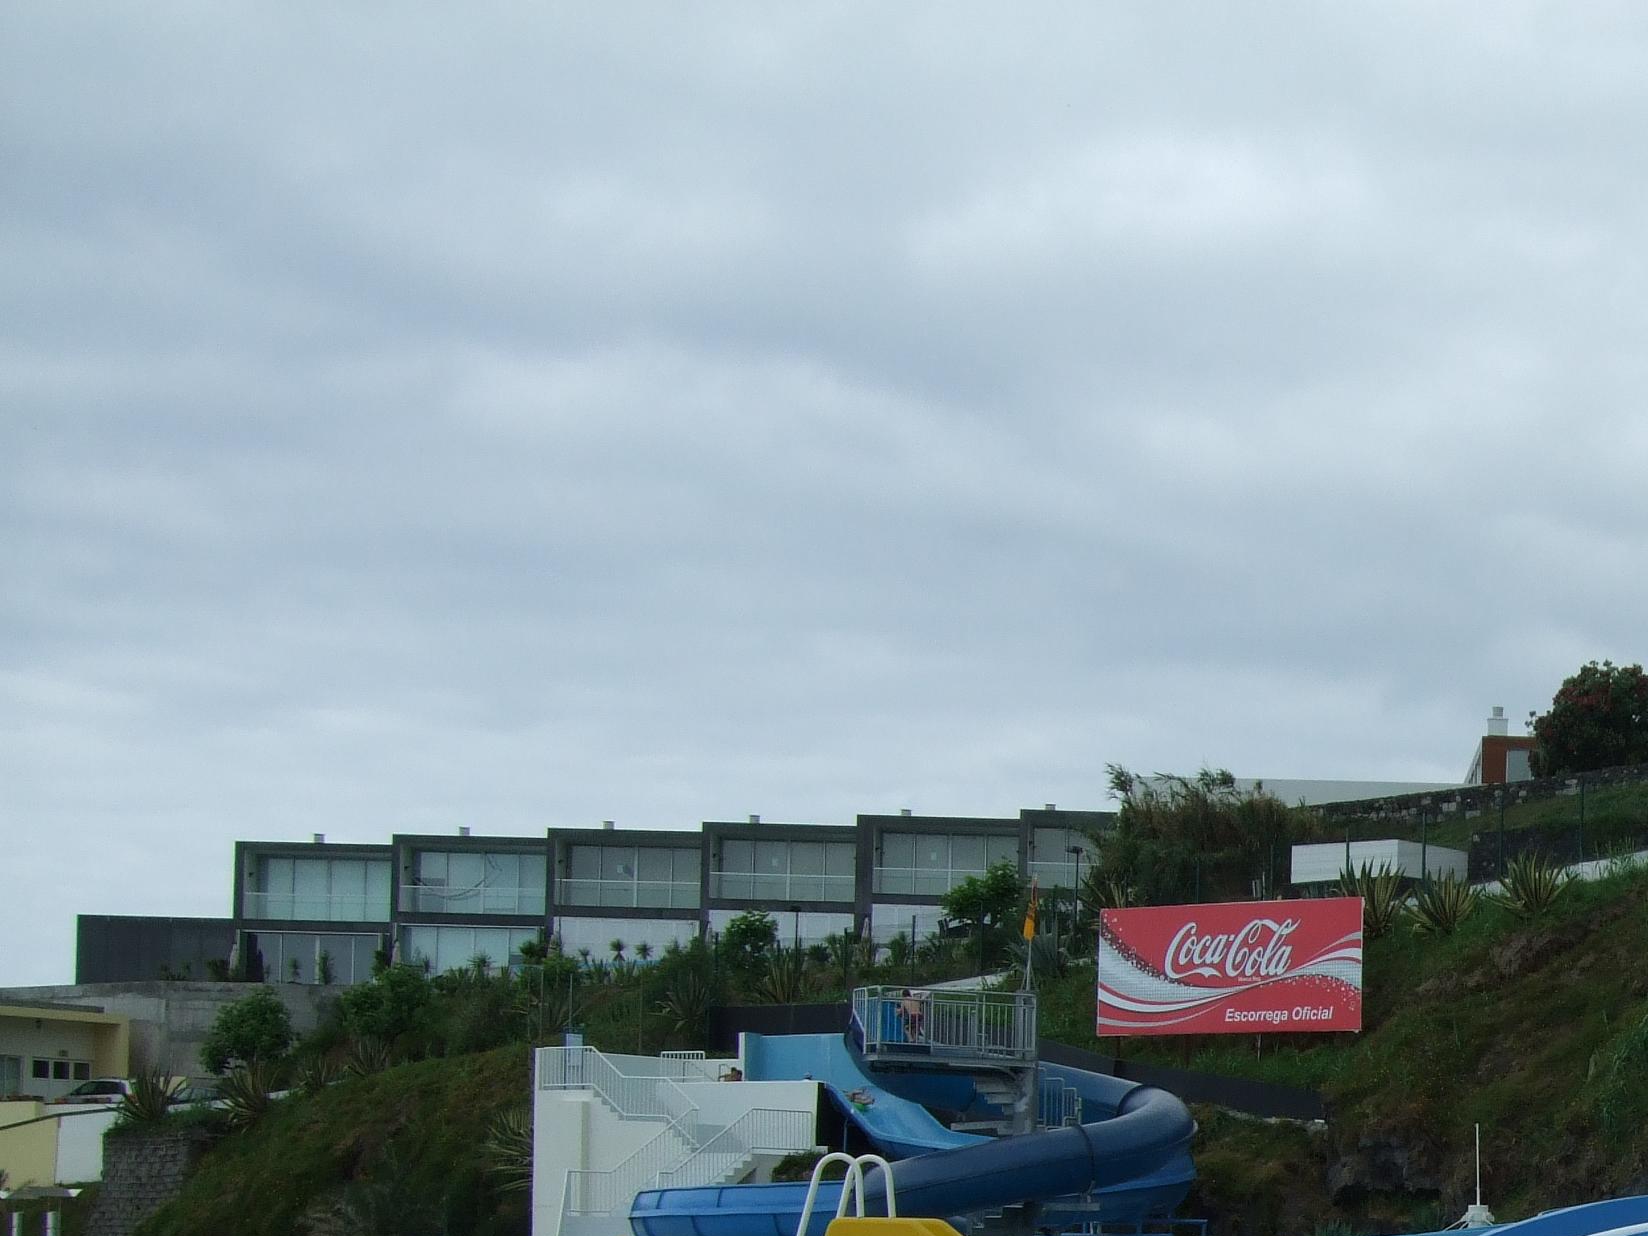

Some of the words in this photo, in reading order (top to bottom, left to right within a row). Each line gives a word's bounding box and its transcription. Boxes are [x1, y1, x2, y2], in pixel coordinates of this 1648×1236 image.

[1164, 917, 1302, 978] Coca-Cola
[1225, 1008, 1289, 1024] Escorrega
[1292, 1006, 1333, 1022] Oficial
